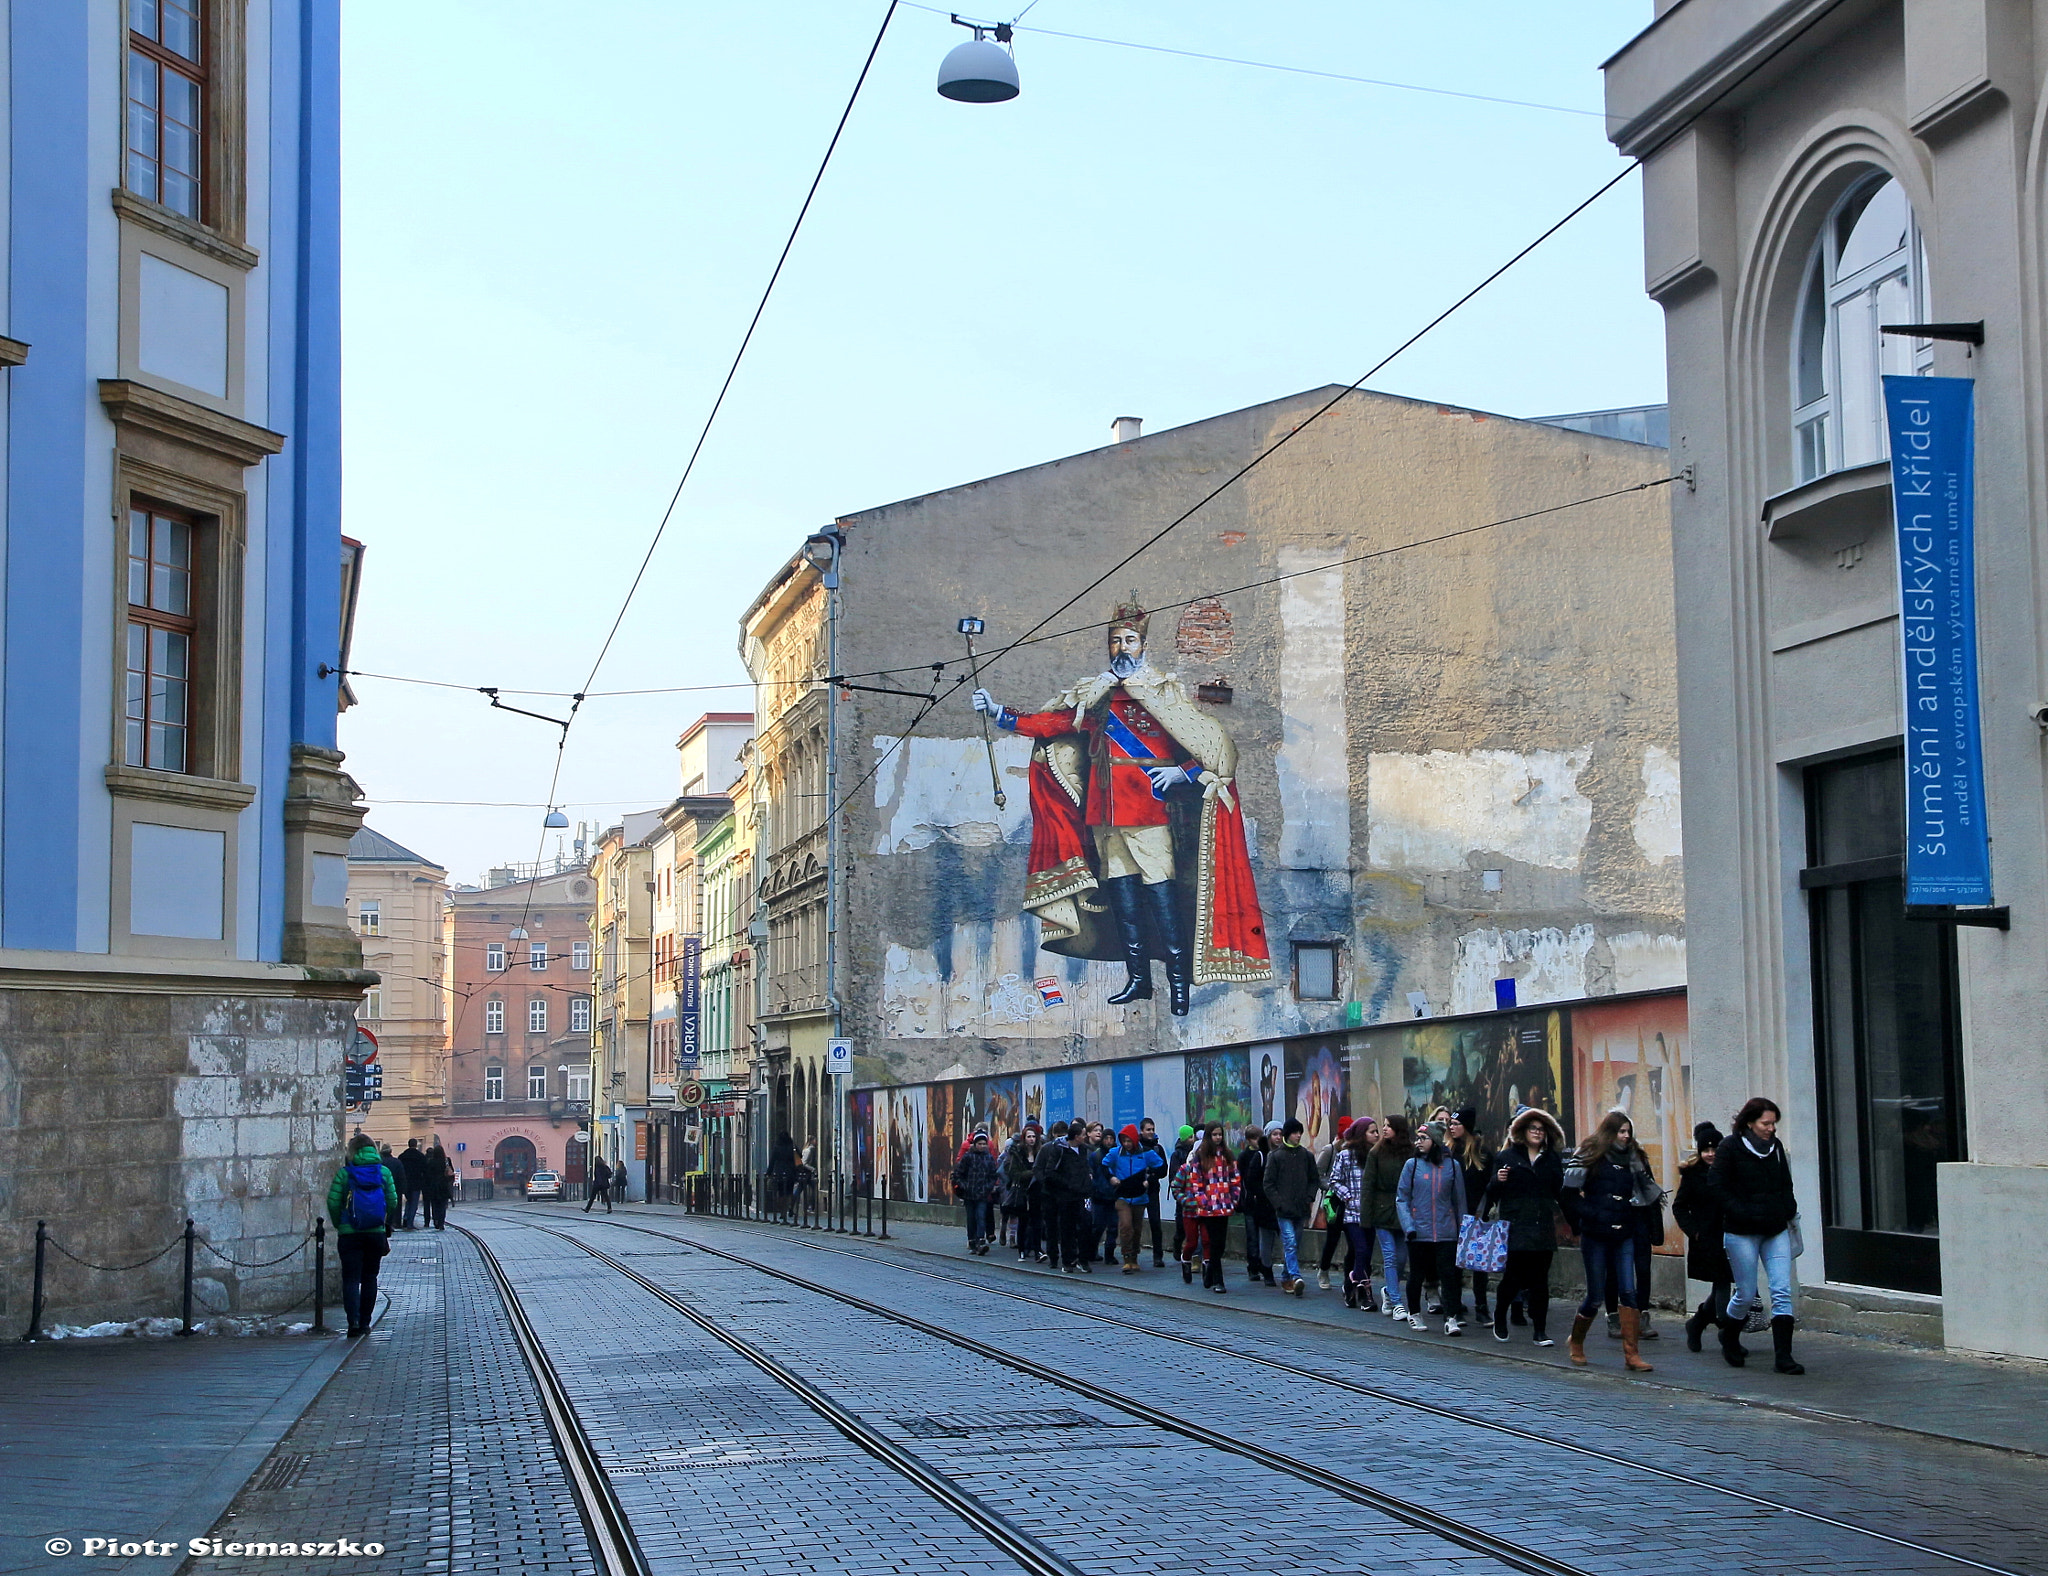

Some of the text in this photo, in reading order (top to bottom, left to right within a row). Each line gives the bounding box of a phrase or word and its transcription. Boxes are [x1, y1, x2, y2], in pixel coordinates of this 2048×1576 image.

[1901, 400, 1946, 856] šumění andělských křídel
[1944, 471, 1970, 826] anděl v evropském výtvarném umění
[684, 1016, 695, 1054] ORKA
